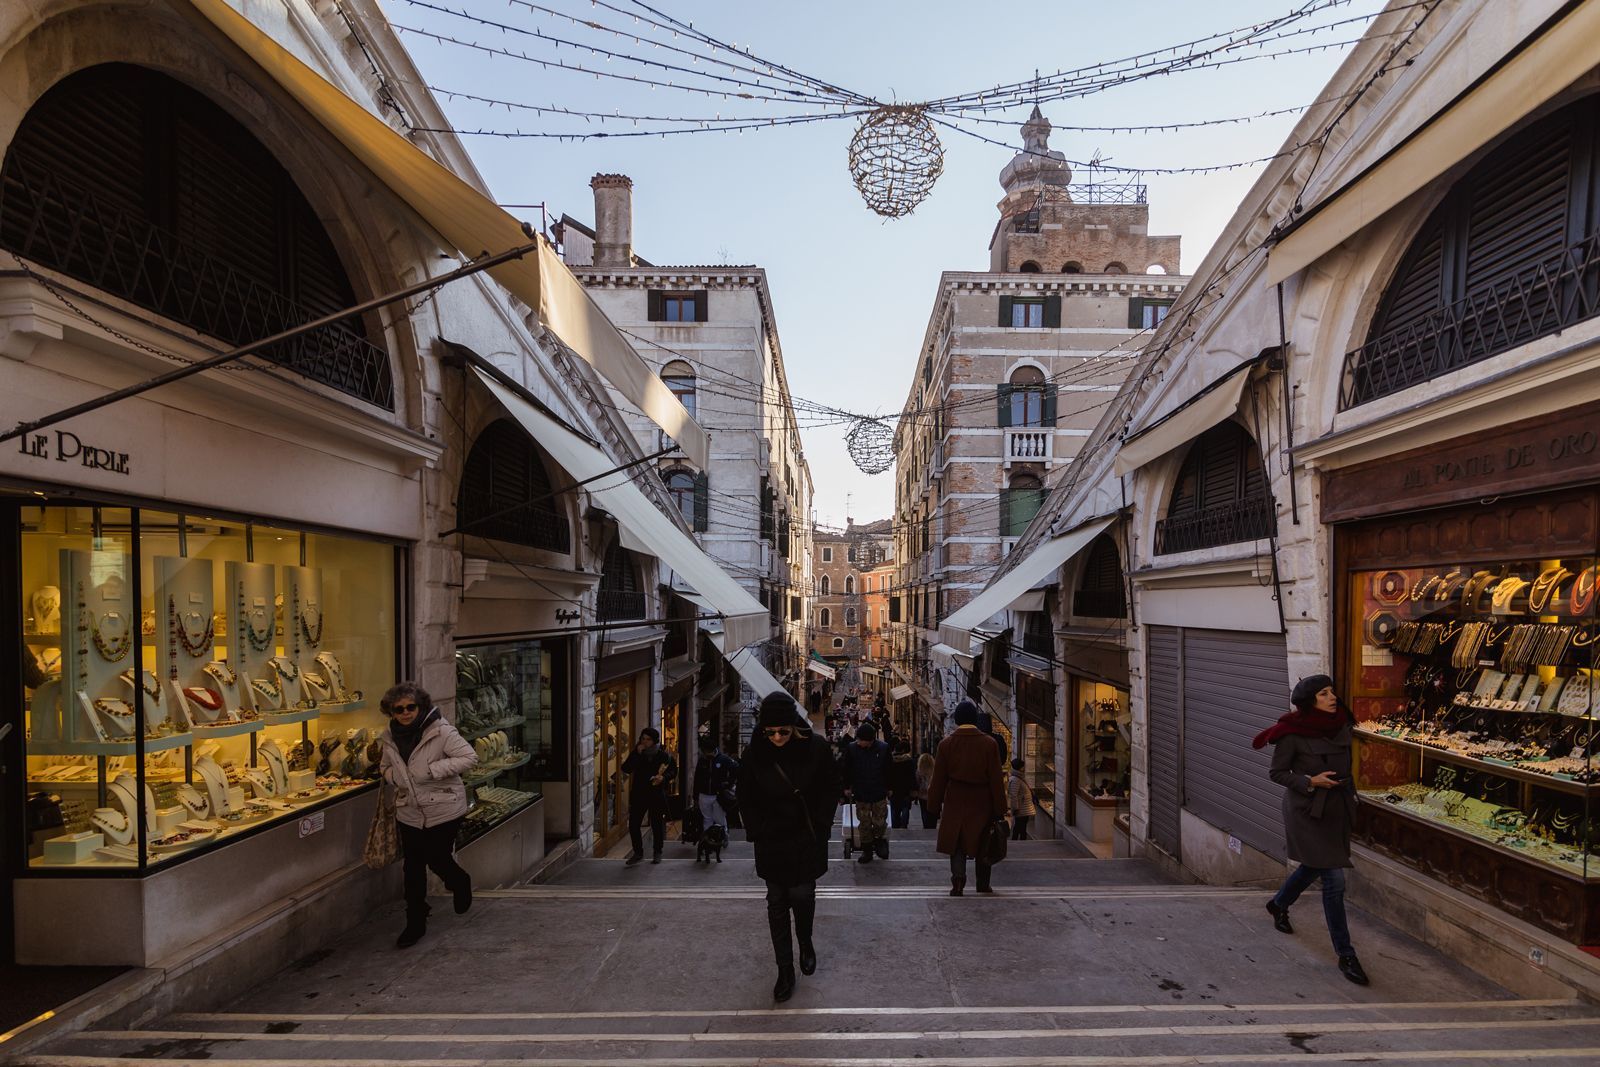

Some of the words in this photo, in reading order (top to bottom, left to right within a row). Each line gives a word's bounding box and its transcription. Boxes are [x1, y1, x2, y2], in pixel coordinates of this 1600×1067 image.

[18, 421, 48, 459] LE
[55, 430, 130, 475] PERLE
[1434, 454, 1495, 484] PONTE
[1505, 443, 1536, 470] DE
[1548, 431, 1598, 461] ORO
